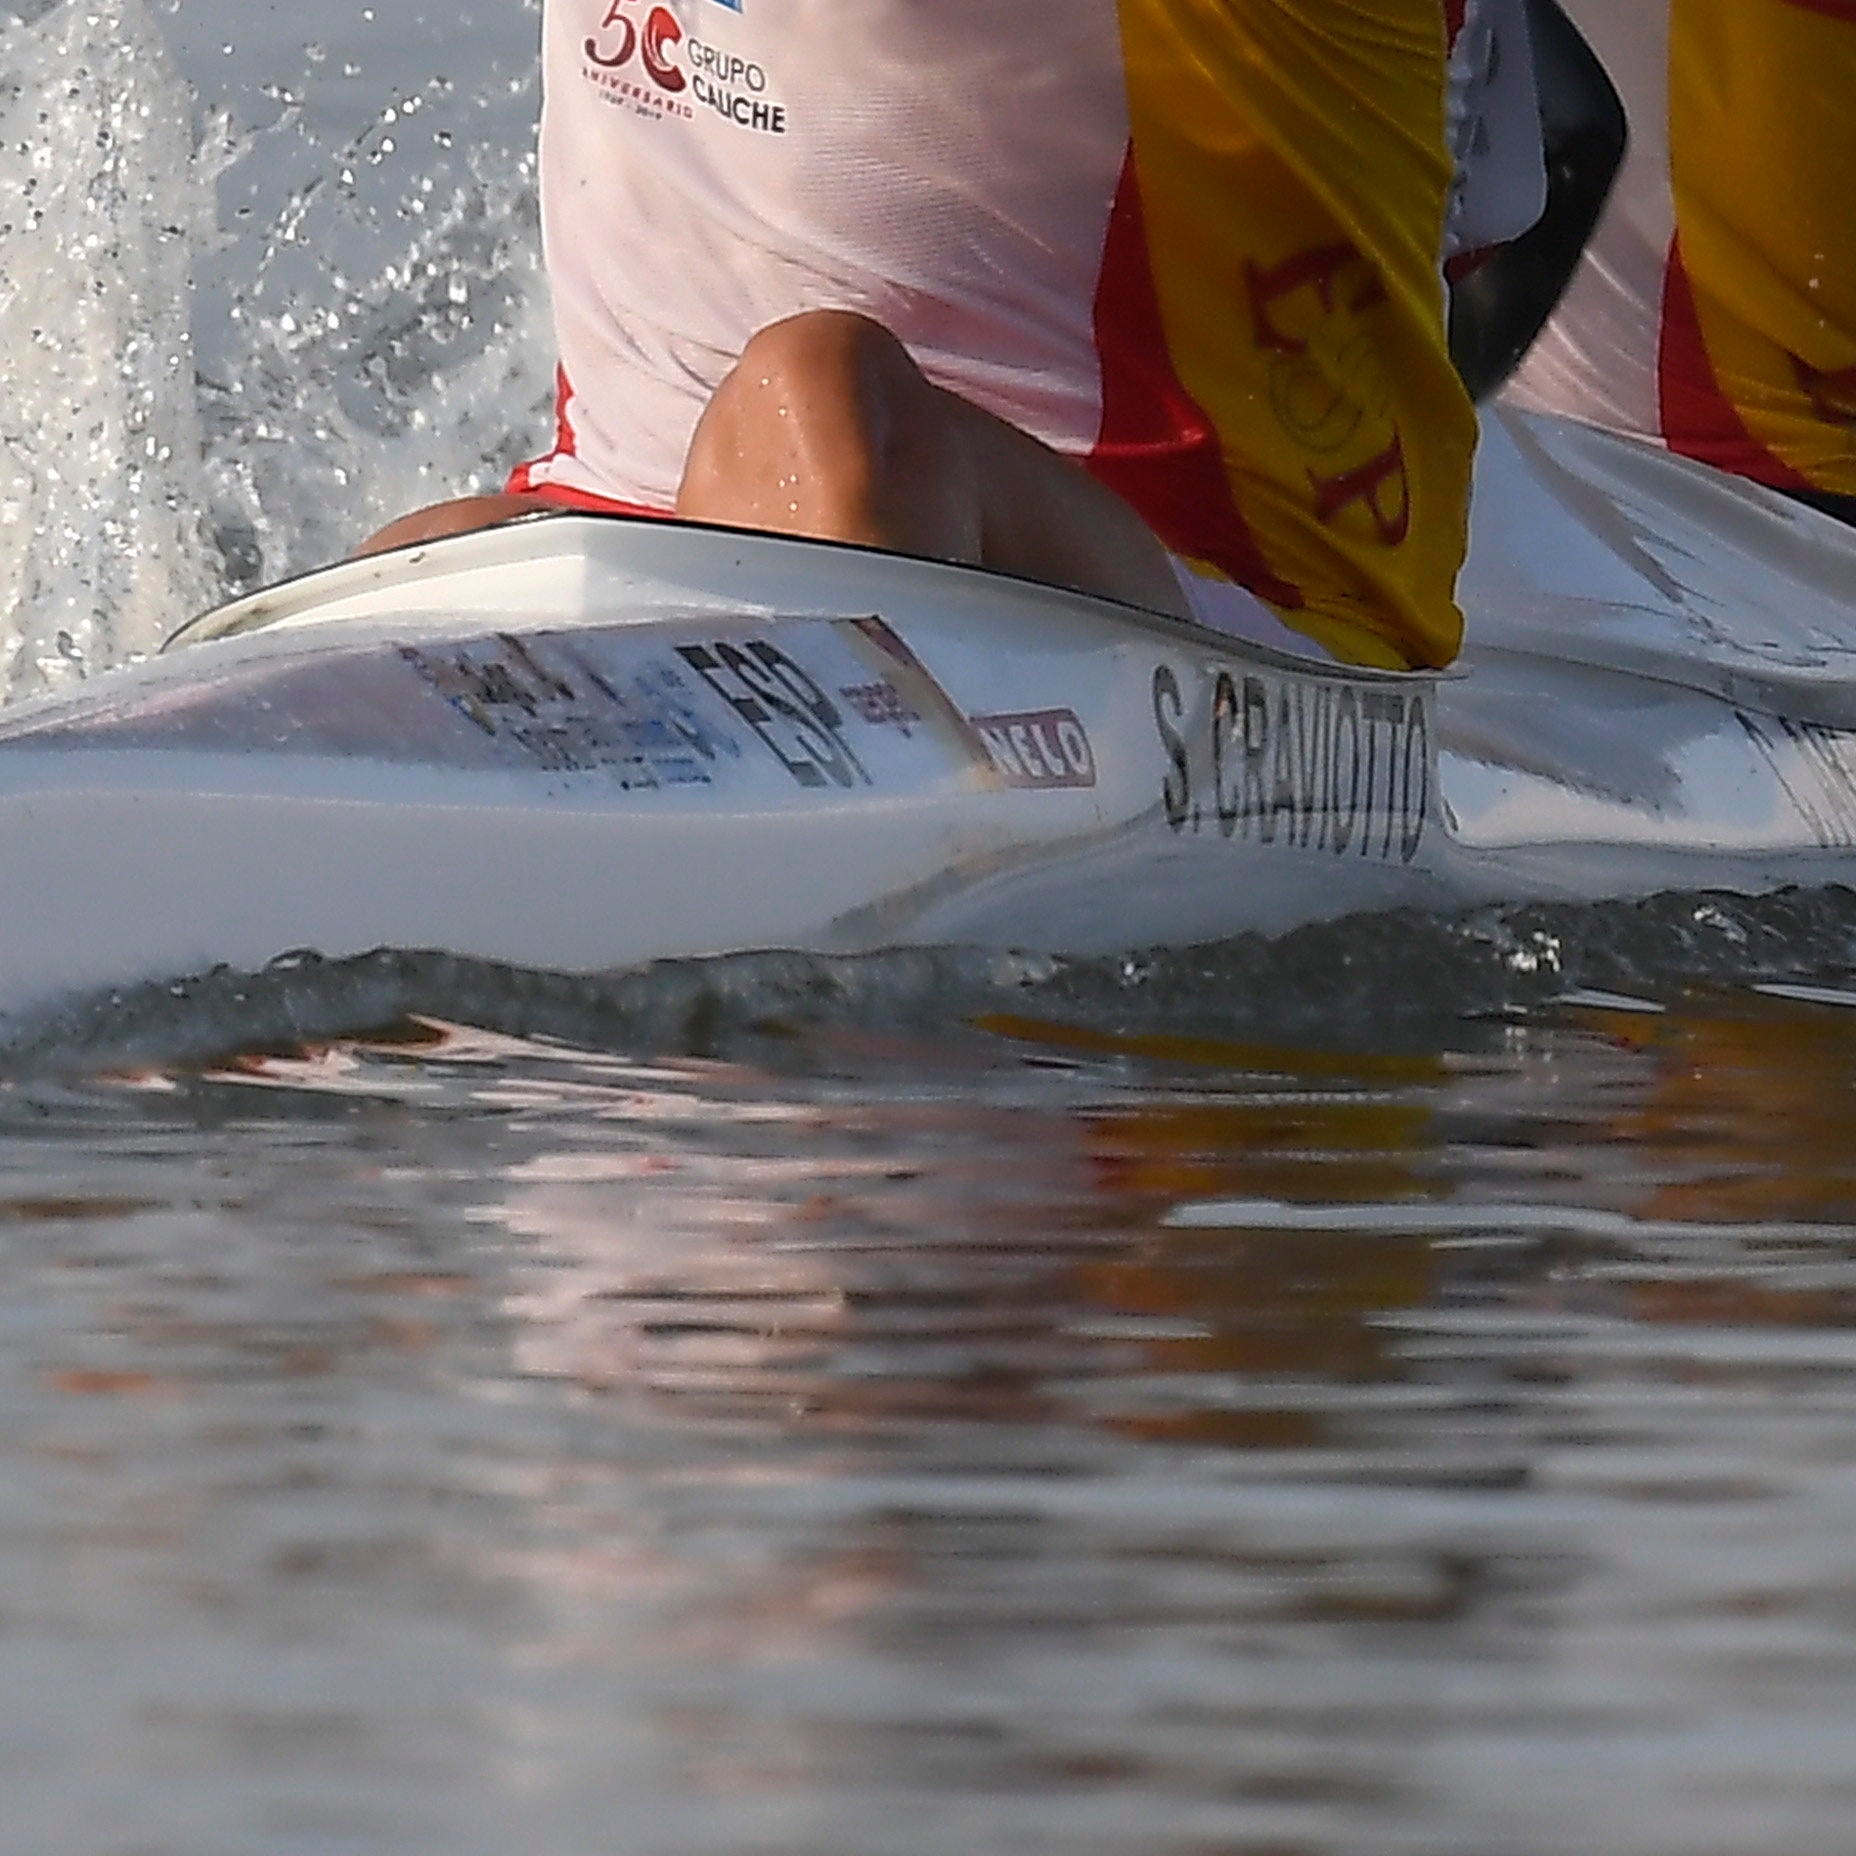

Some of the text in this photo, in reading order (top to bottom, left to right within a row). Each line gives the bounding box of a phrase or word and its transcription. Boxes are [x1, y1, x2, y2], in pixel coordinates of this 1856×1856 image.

[688, 38, 765, 92] GRUPO
[674, 640, 874, 789] ESP
[976, 719, 1094, 777] NELO
